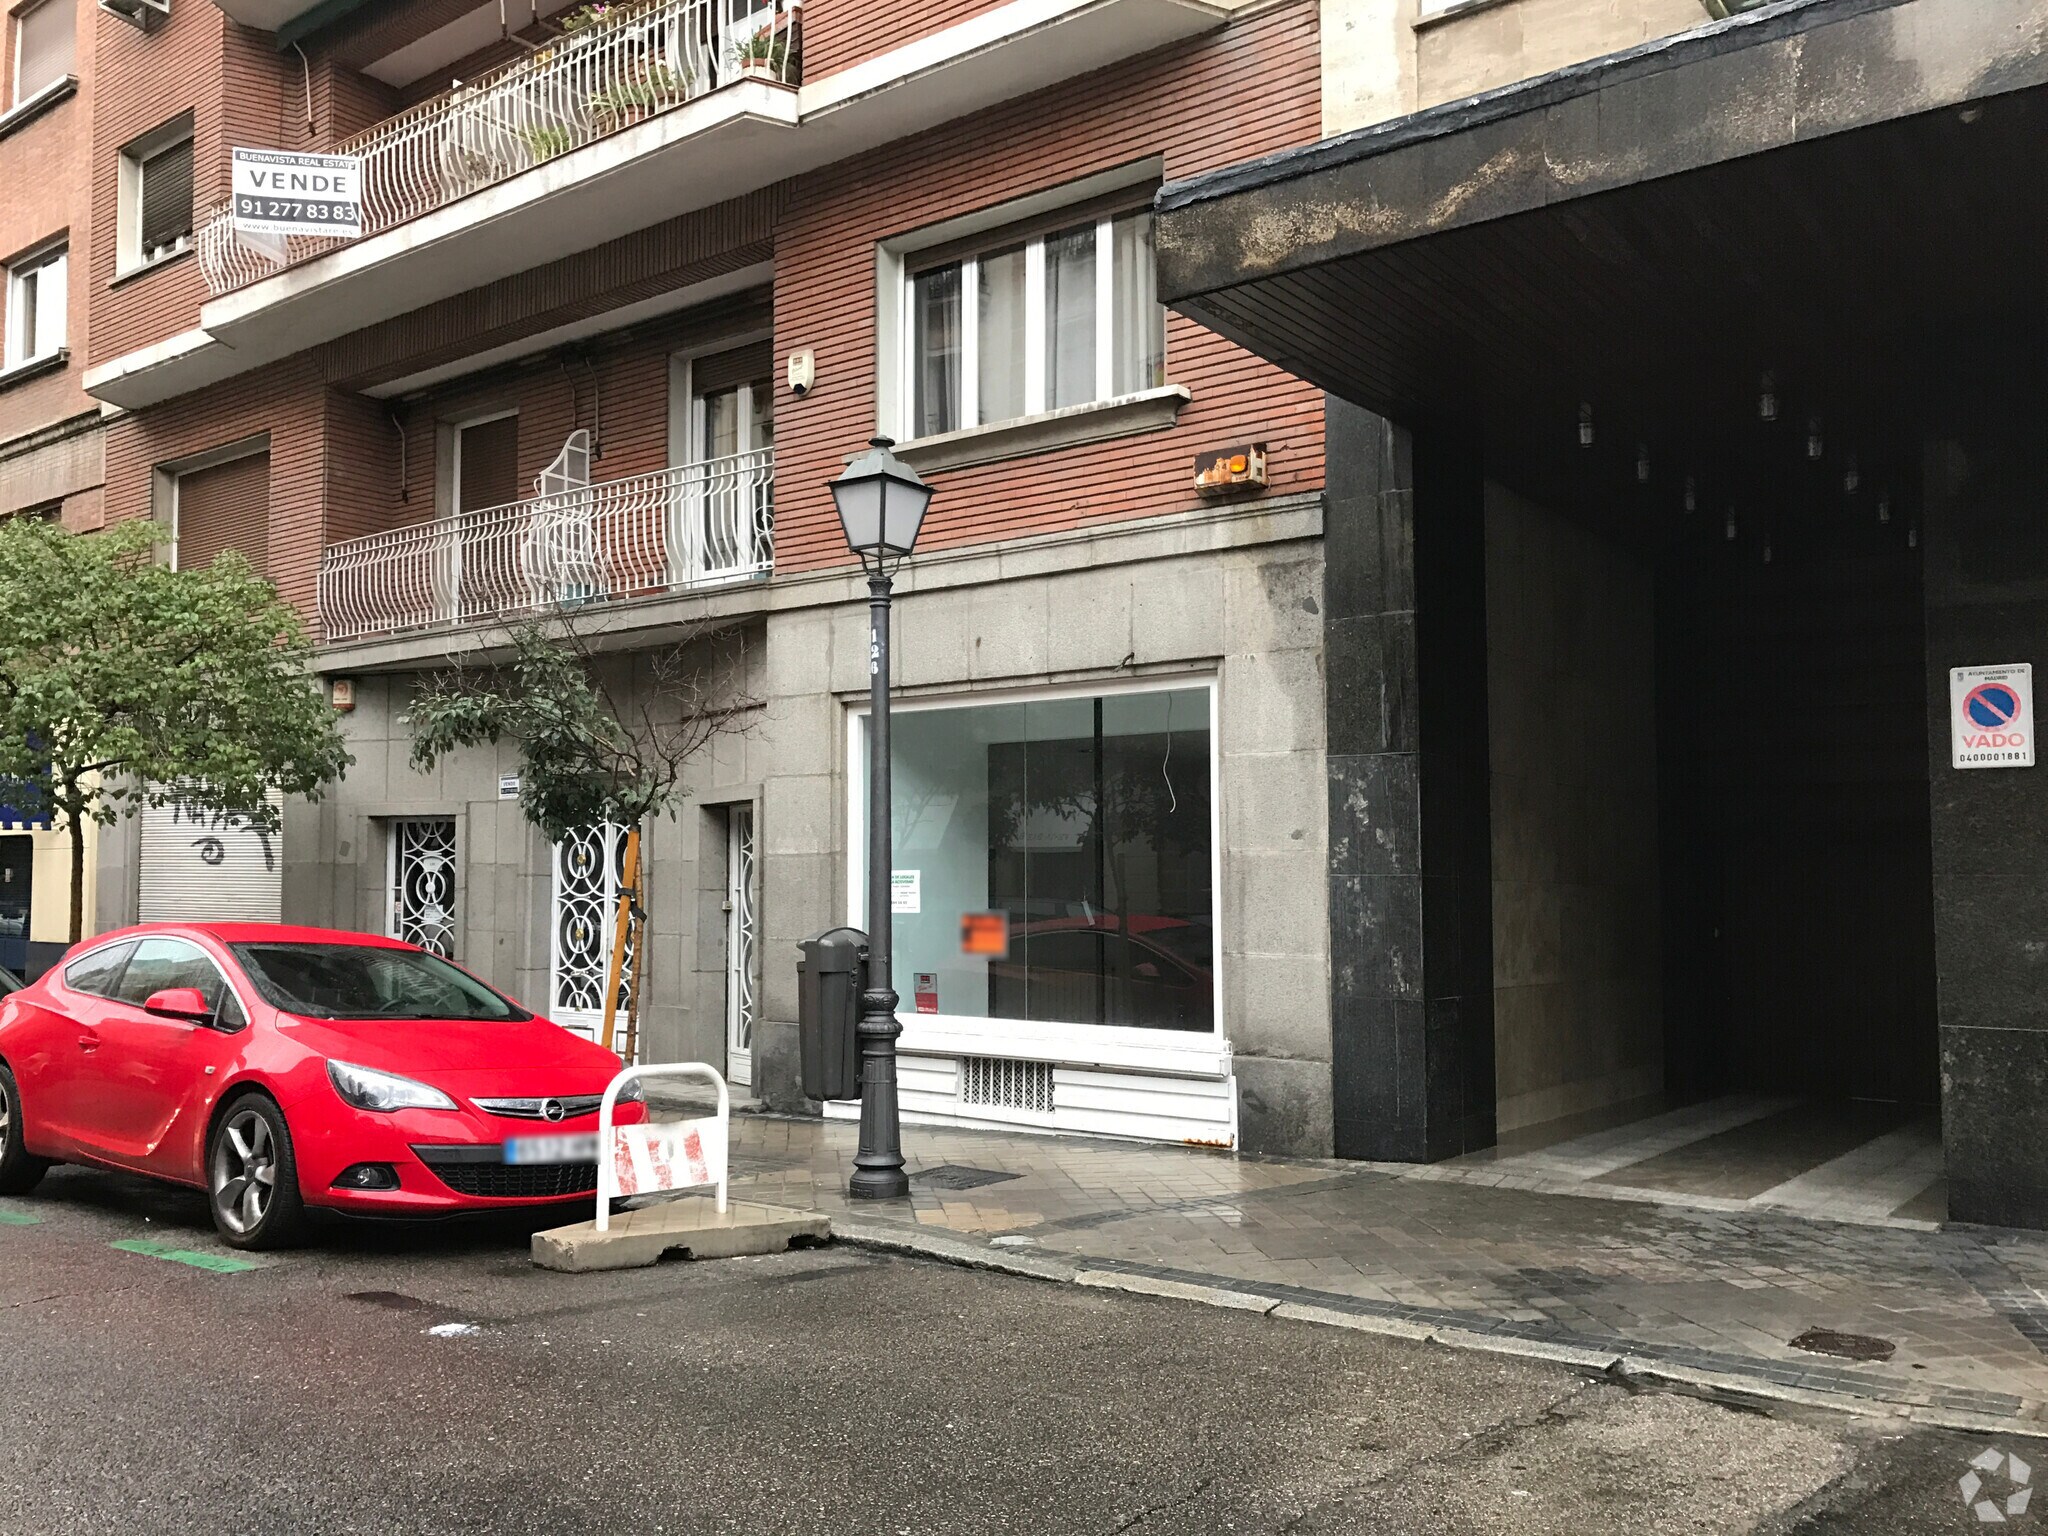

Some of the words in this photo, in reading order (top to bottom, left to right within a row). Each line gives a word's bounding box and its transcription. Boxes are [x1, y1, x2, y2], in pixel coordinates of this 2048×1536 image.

[239, 152, 296, 165] BUENAVISTA
[298, 157, 321, 167] REAL
[322, 159, 355, 169] ESTATE
[250, 170, 346, 193] VENDE
[241, 199, 264, 215] 91
[268, 201, 302, 217] 277
[306, 204, 328, 219] 83
[332, 206, 355, 221] 83
[1961, 733, 2025, 748] VADO
[1959, 752, 2026, 762] 0400001881
